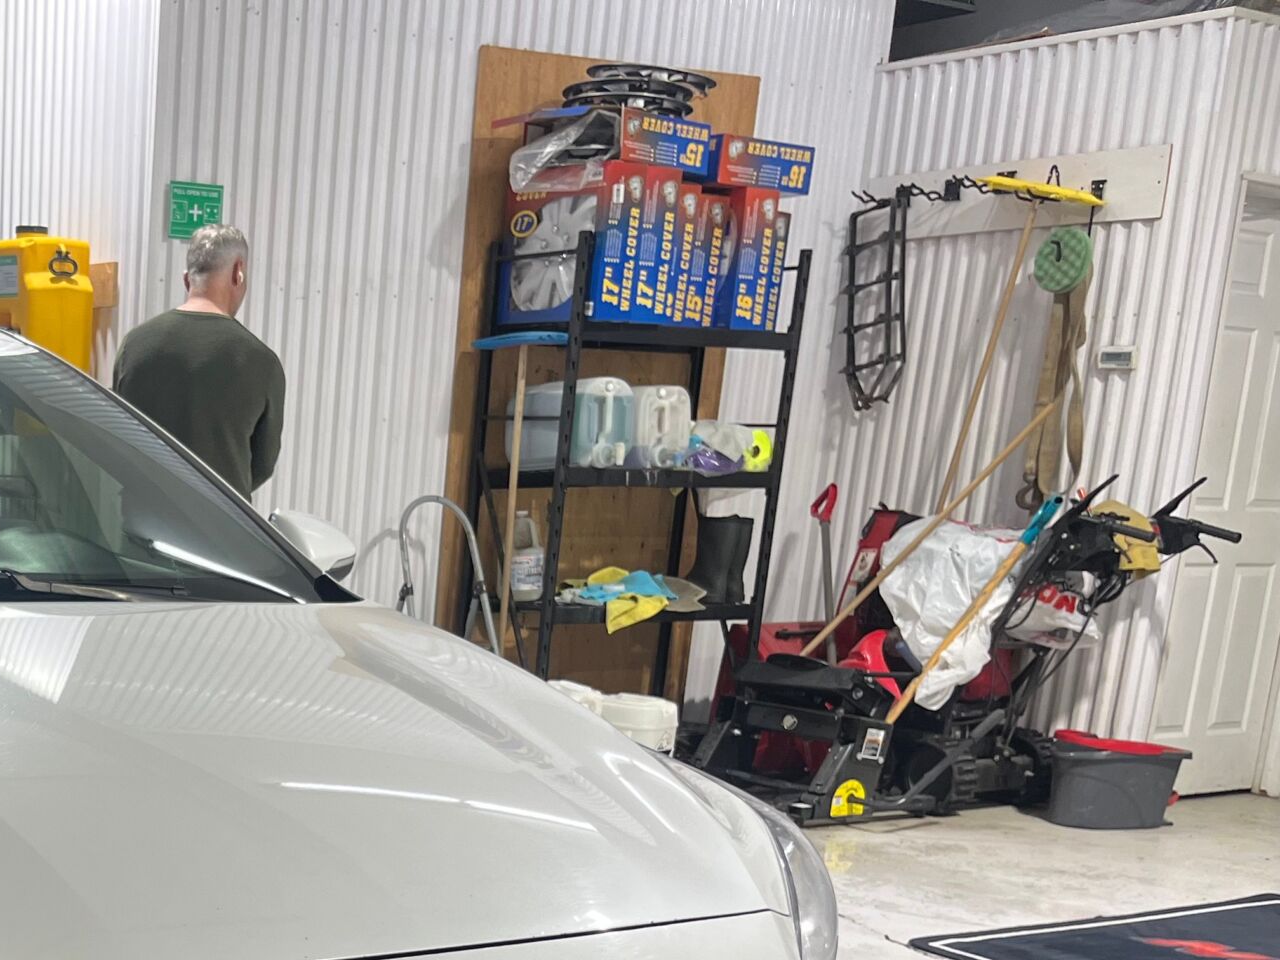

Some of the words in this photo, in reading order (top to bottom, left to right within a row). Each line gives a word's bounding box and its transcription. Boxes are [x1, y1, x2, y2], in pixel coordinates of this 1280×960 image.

[642, 116, 674, 136] COVER
[675, 123, 709, 142] WHEEL
[626, 207, 641, 257] COVER
[661, 211, 675, 261] COVER
[680, 222, 694, 270] COVER
[708, 227, 723, 275] COVER
[759, 227, 773, 274] COVER
[601, 266, 620, 306] 17"
[620, 259, 635, 312] WHEEL
[636, 269, 654, 309] 17"
[654, 263, 669, 315] WHEEL
[673, 272, 688, 322] WHEEL
[701, 278, 717, 328] WHEEL
[752, 276, 767, 326] WHEEL
